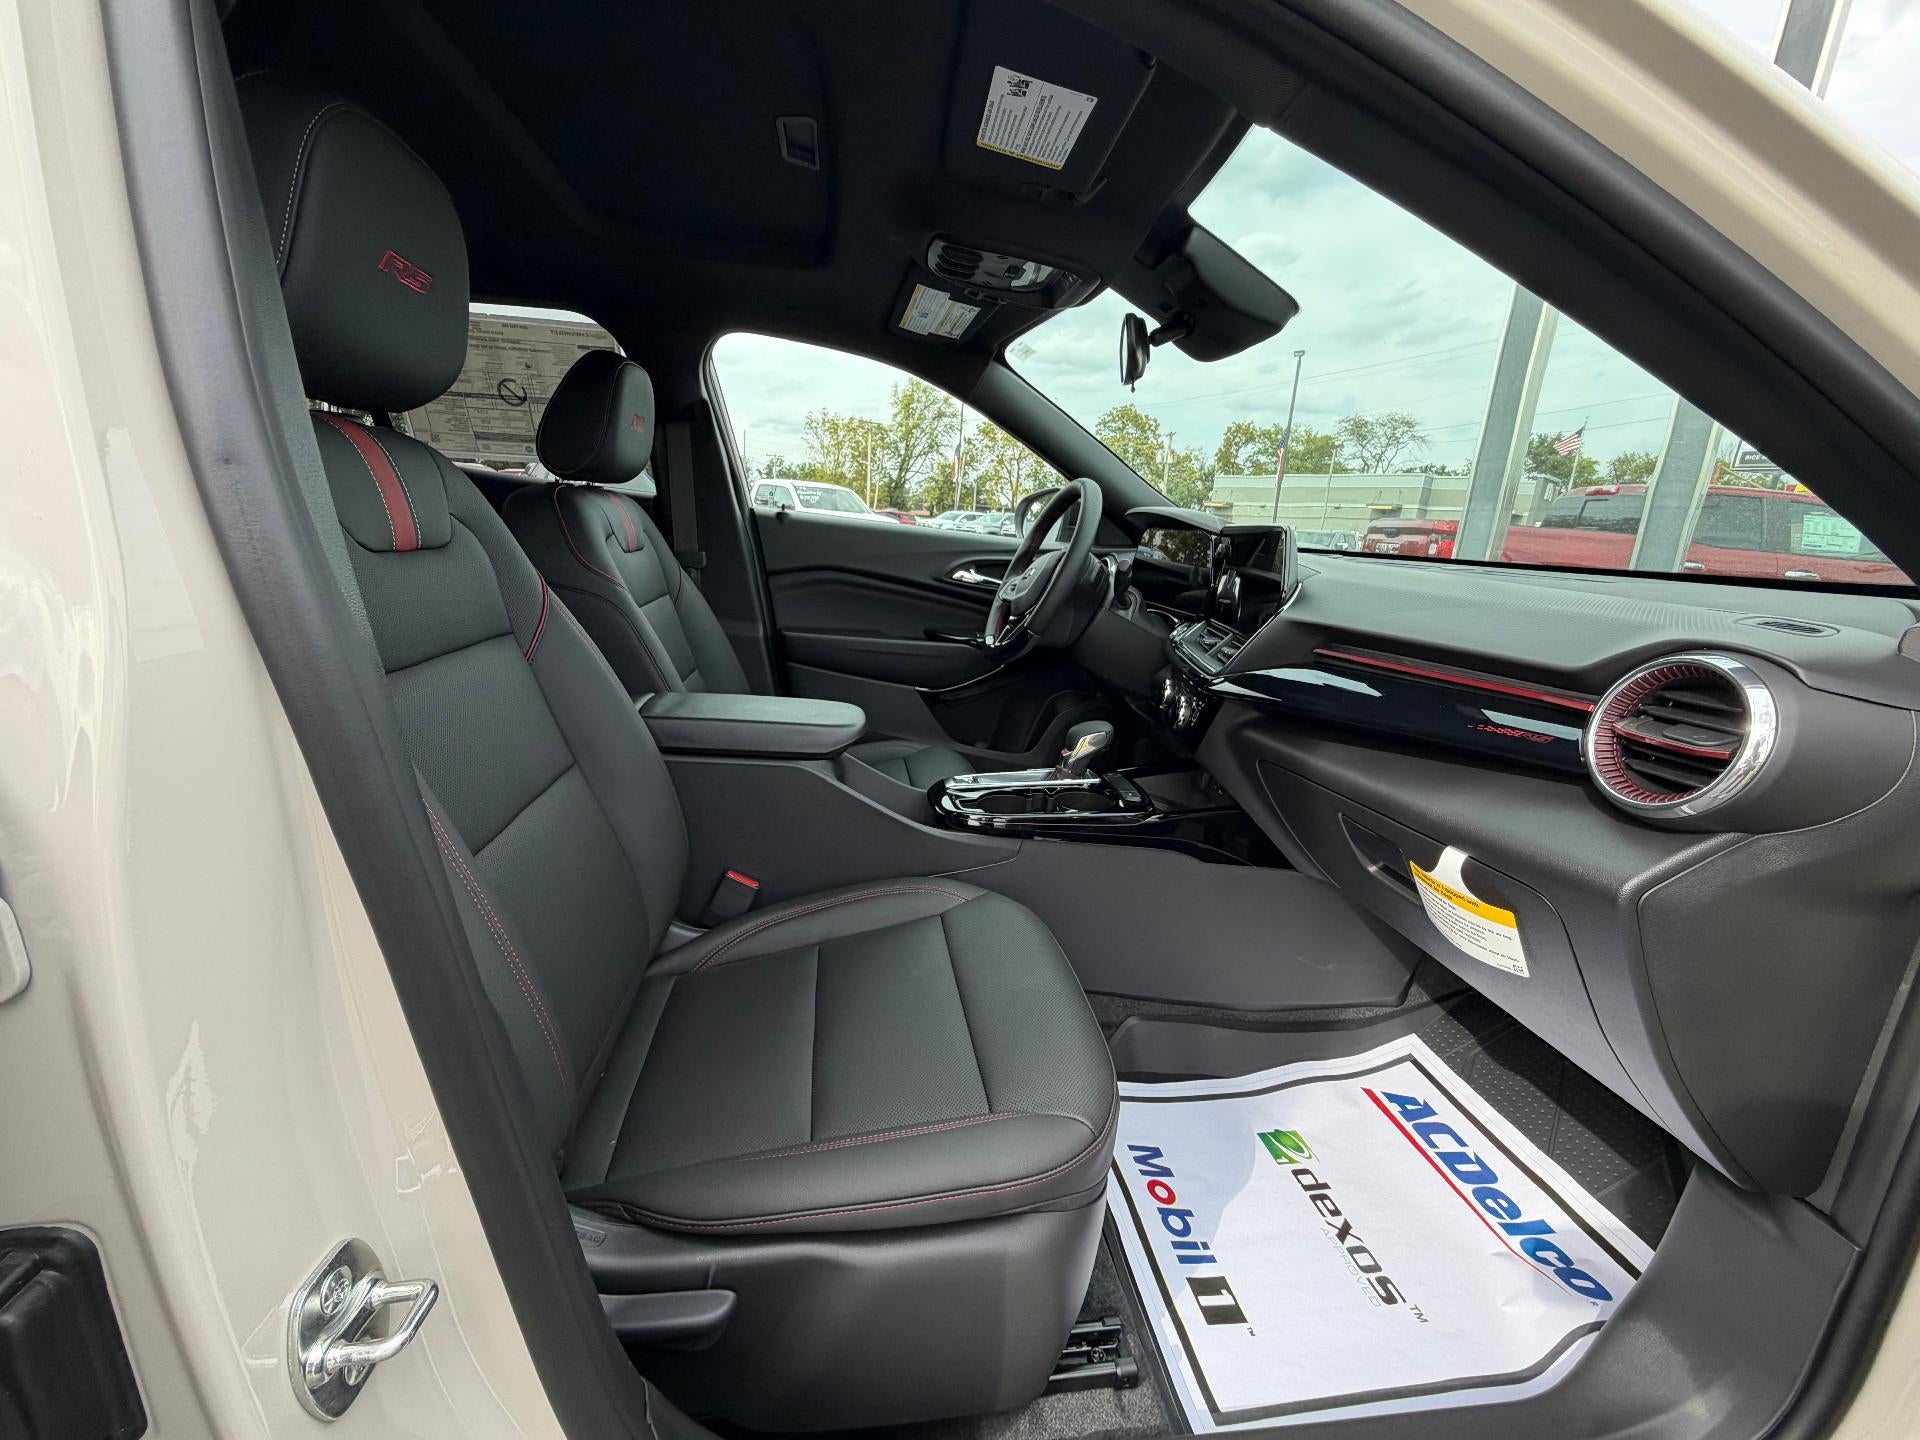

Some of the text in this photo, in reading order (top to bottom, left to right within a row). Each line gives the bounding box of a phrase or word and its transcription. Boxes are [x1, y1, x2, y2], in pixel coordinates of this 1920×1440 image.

[1127, 1144, 1218, 1264] Mobil
[1291, 1168, 1407, 1305] dexos
[1380, 1090, 1614, 1301] ACDelco
[1319, 1227, 1382, 1308] APPROVED
